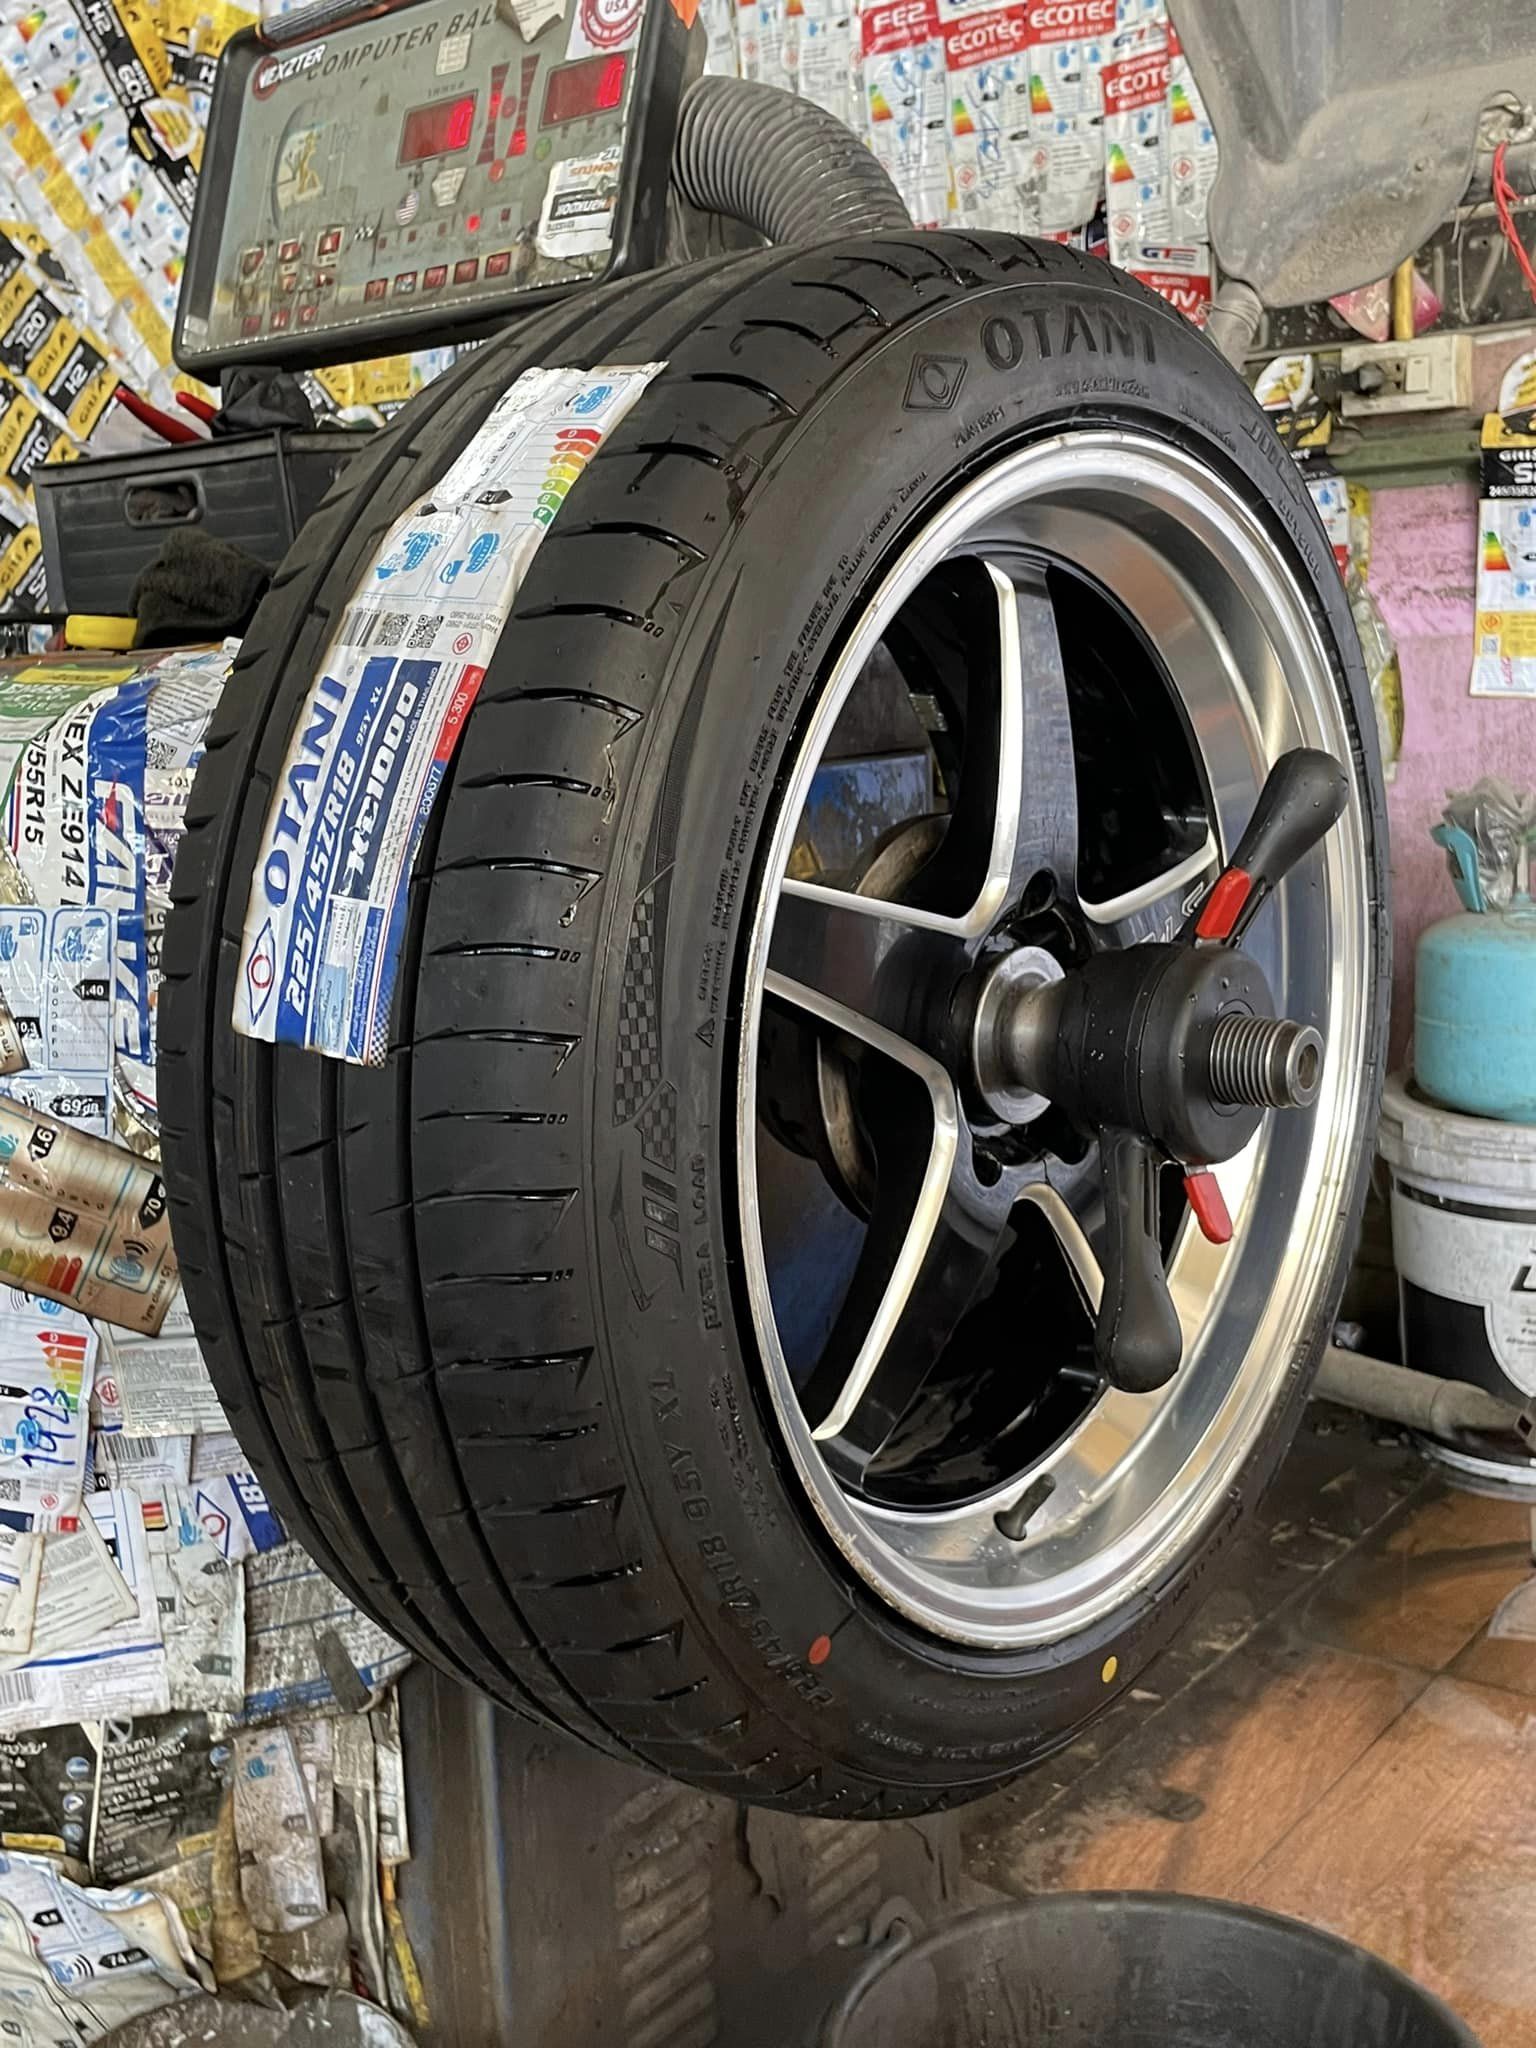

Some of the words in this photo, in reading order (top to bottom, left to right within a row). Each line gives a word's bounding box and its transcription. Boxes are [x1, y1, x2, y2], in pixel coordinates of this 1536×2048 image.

[446, 2, 500, 36] BAL
[947, 18, 1023, 56] ECOTEC
[1030, 0, 1112, 29] ECOTEC
[981, 304, 1157, 371] OTANI
[264, 674, 348, 911] OTANI
[60, 777, 86, 896] ZE914
[289, 748, 358, 1018] 225/45ZR18
[369, 684, 385, 712] XL
[94, 778, 144, 1062] FALKE
[60, 1098, 81, 1114] 69
[144, 1197, 161, 1219] 70
[664, 1446, 713, 1524] 95Y
